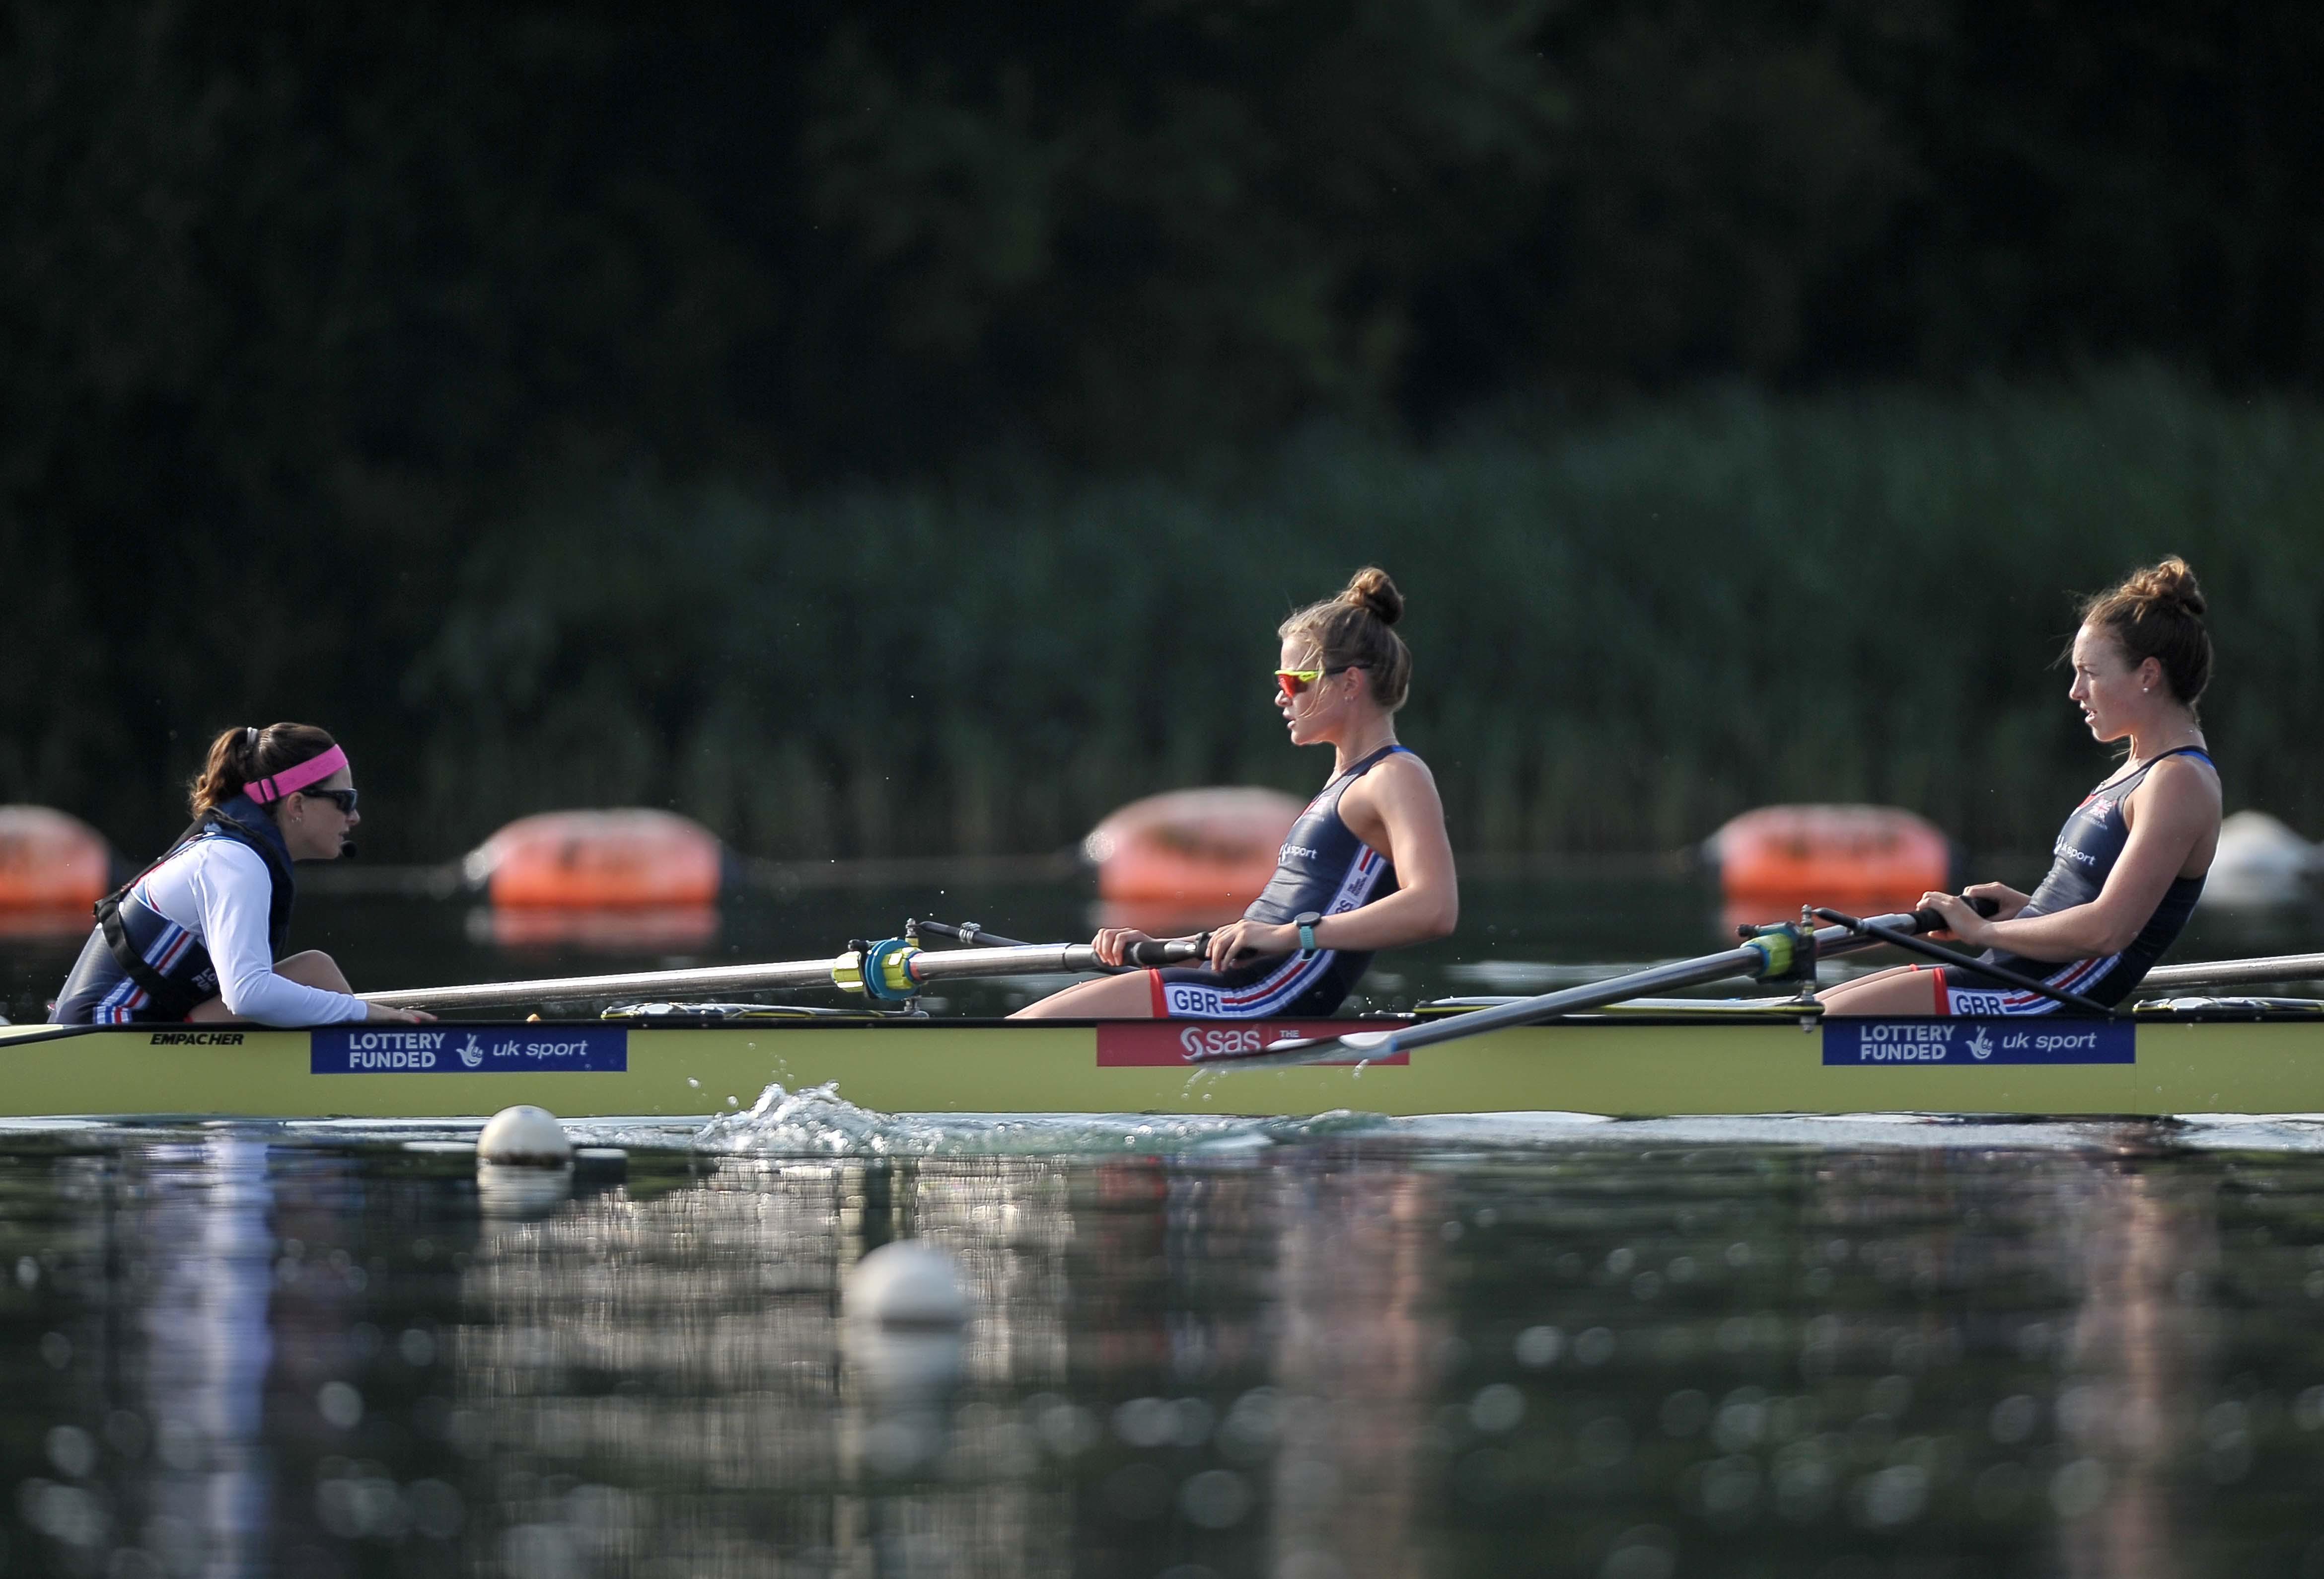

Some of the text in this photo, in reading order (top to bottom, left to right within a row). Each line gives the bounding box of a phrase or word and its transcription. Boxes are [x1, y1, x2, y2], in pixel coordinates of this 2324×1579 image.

[1291, 845, 1317, 859] sport
[2067, 845, 2096, 866] sport
[1173, 990, 1221, 1014] GBR
[1956, 994, 2004, 1015] GBR
[150, 1033, 244, 1046] EMPACHER
[349, 1033, 446, 1050] LOTTERY
[1205, 1030, 1262, 1054] sas
[1860, 1025, 1956, 1042] LOTTERY
[2002, 1033, 2098, 1052] uk sport
[493, 1039, 589, 1060] uk sport
[1860, 1044, 1947, 1061] FUNDED
[349, 1051, 436, 1068] FUNDED
